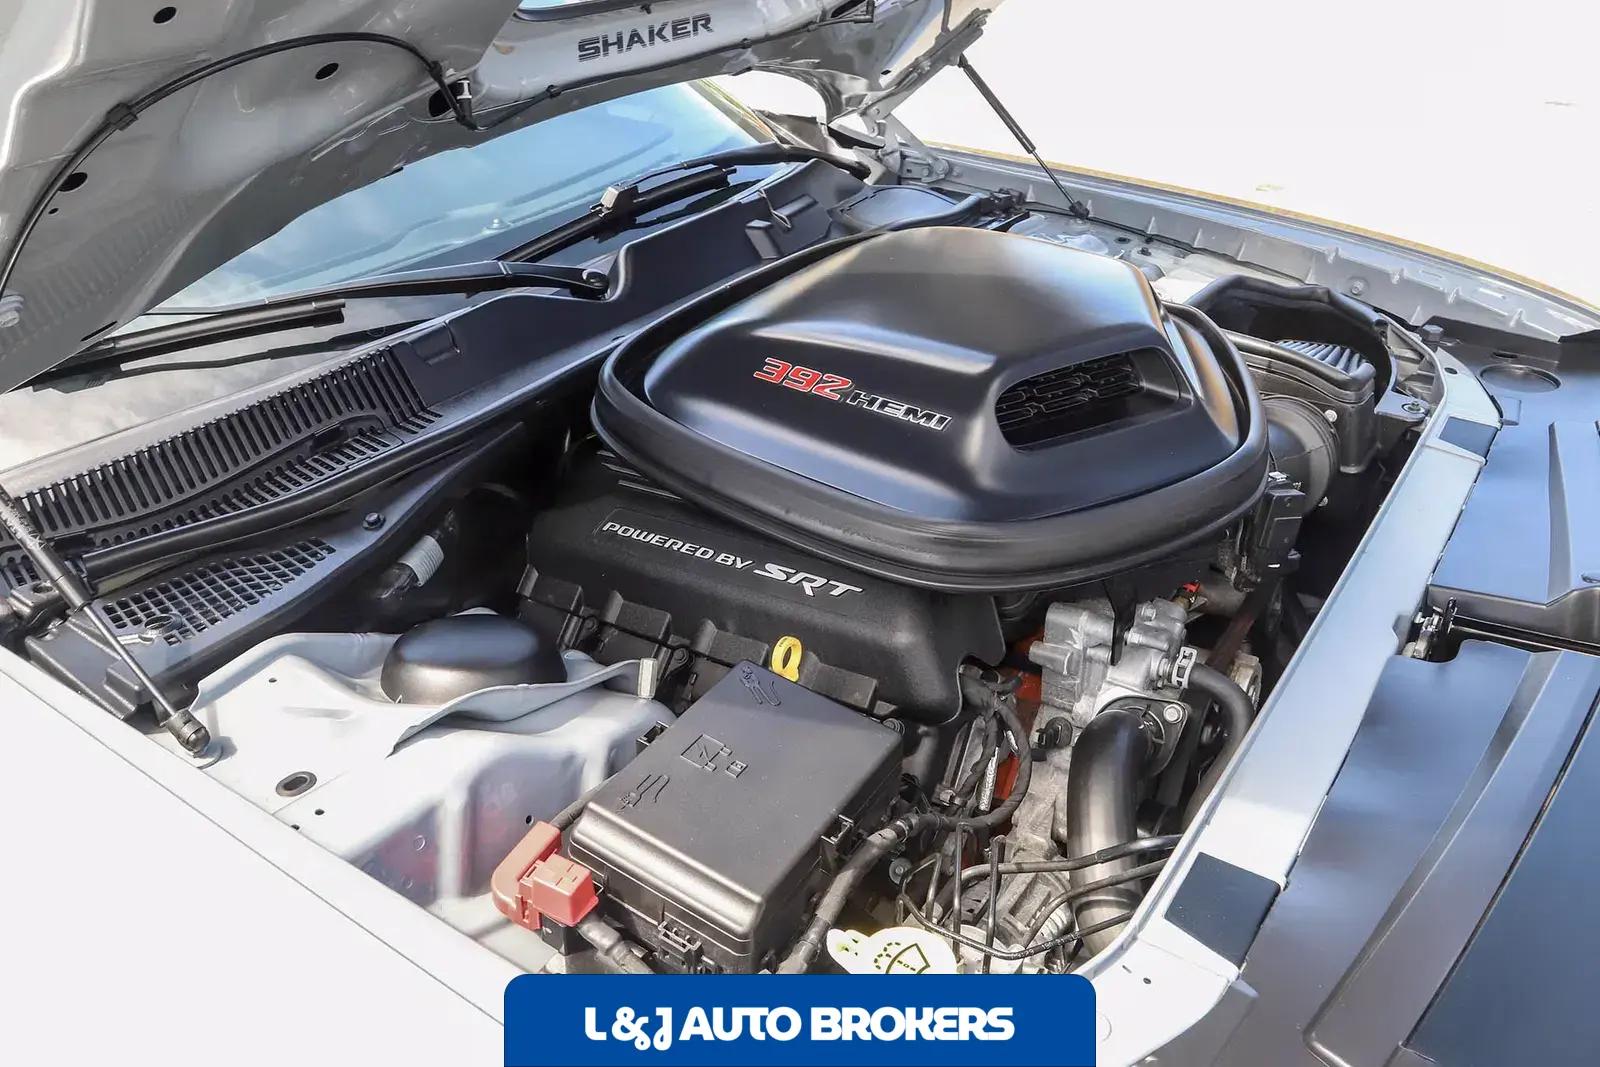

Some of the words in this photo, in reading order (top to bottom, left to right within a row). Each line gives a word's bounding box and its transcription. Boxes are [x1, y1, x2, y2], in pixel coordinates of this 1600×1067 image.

[578, 13, 714, 62] SHAKER
[753, 357, 852, 400] 392
[846, 390, 953, 431] HEMI
[602, 521, 714, 560] POWERED
[714, 552, 753, 570] BY
[753, 562, 863, 597] SRT
